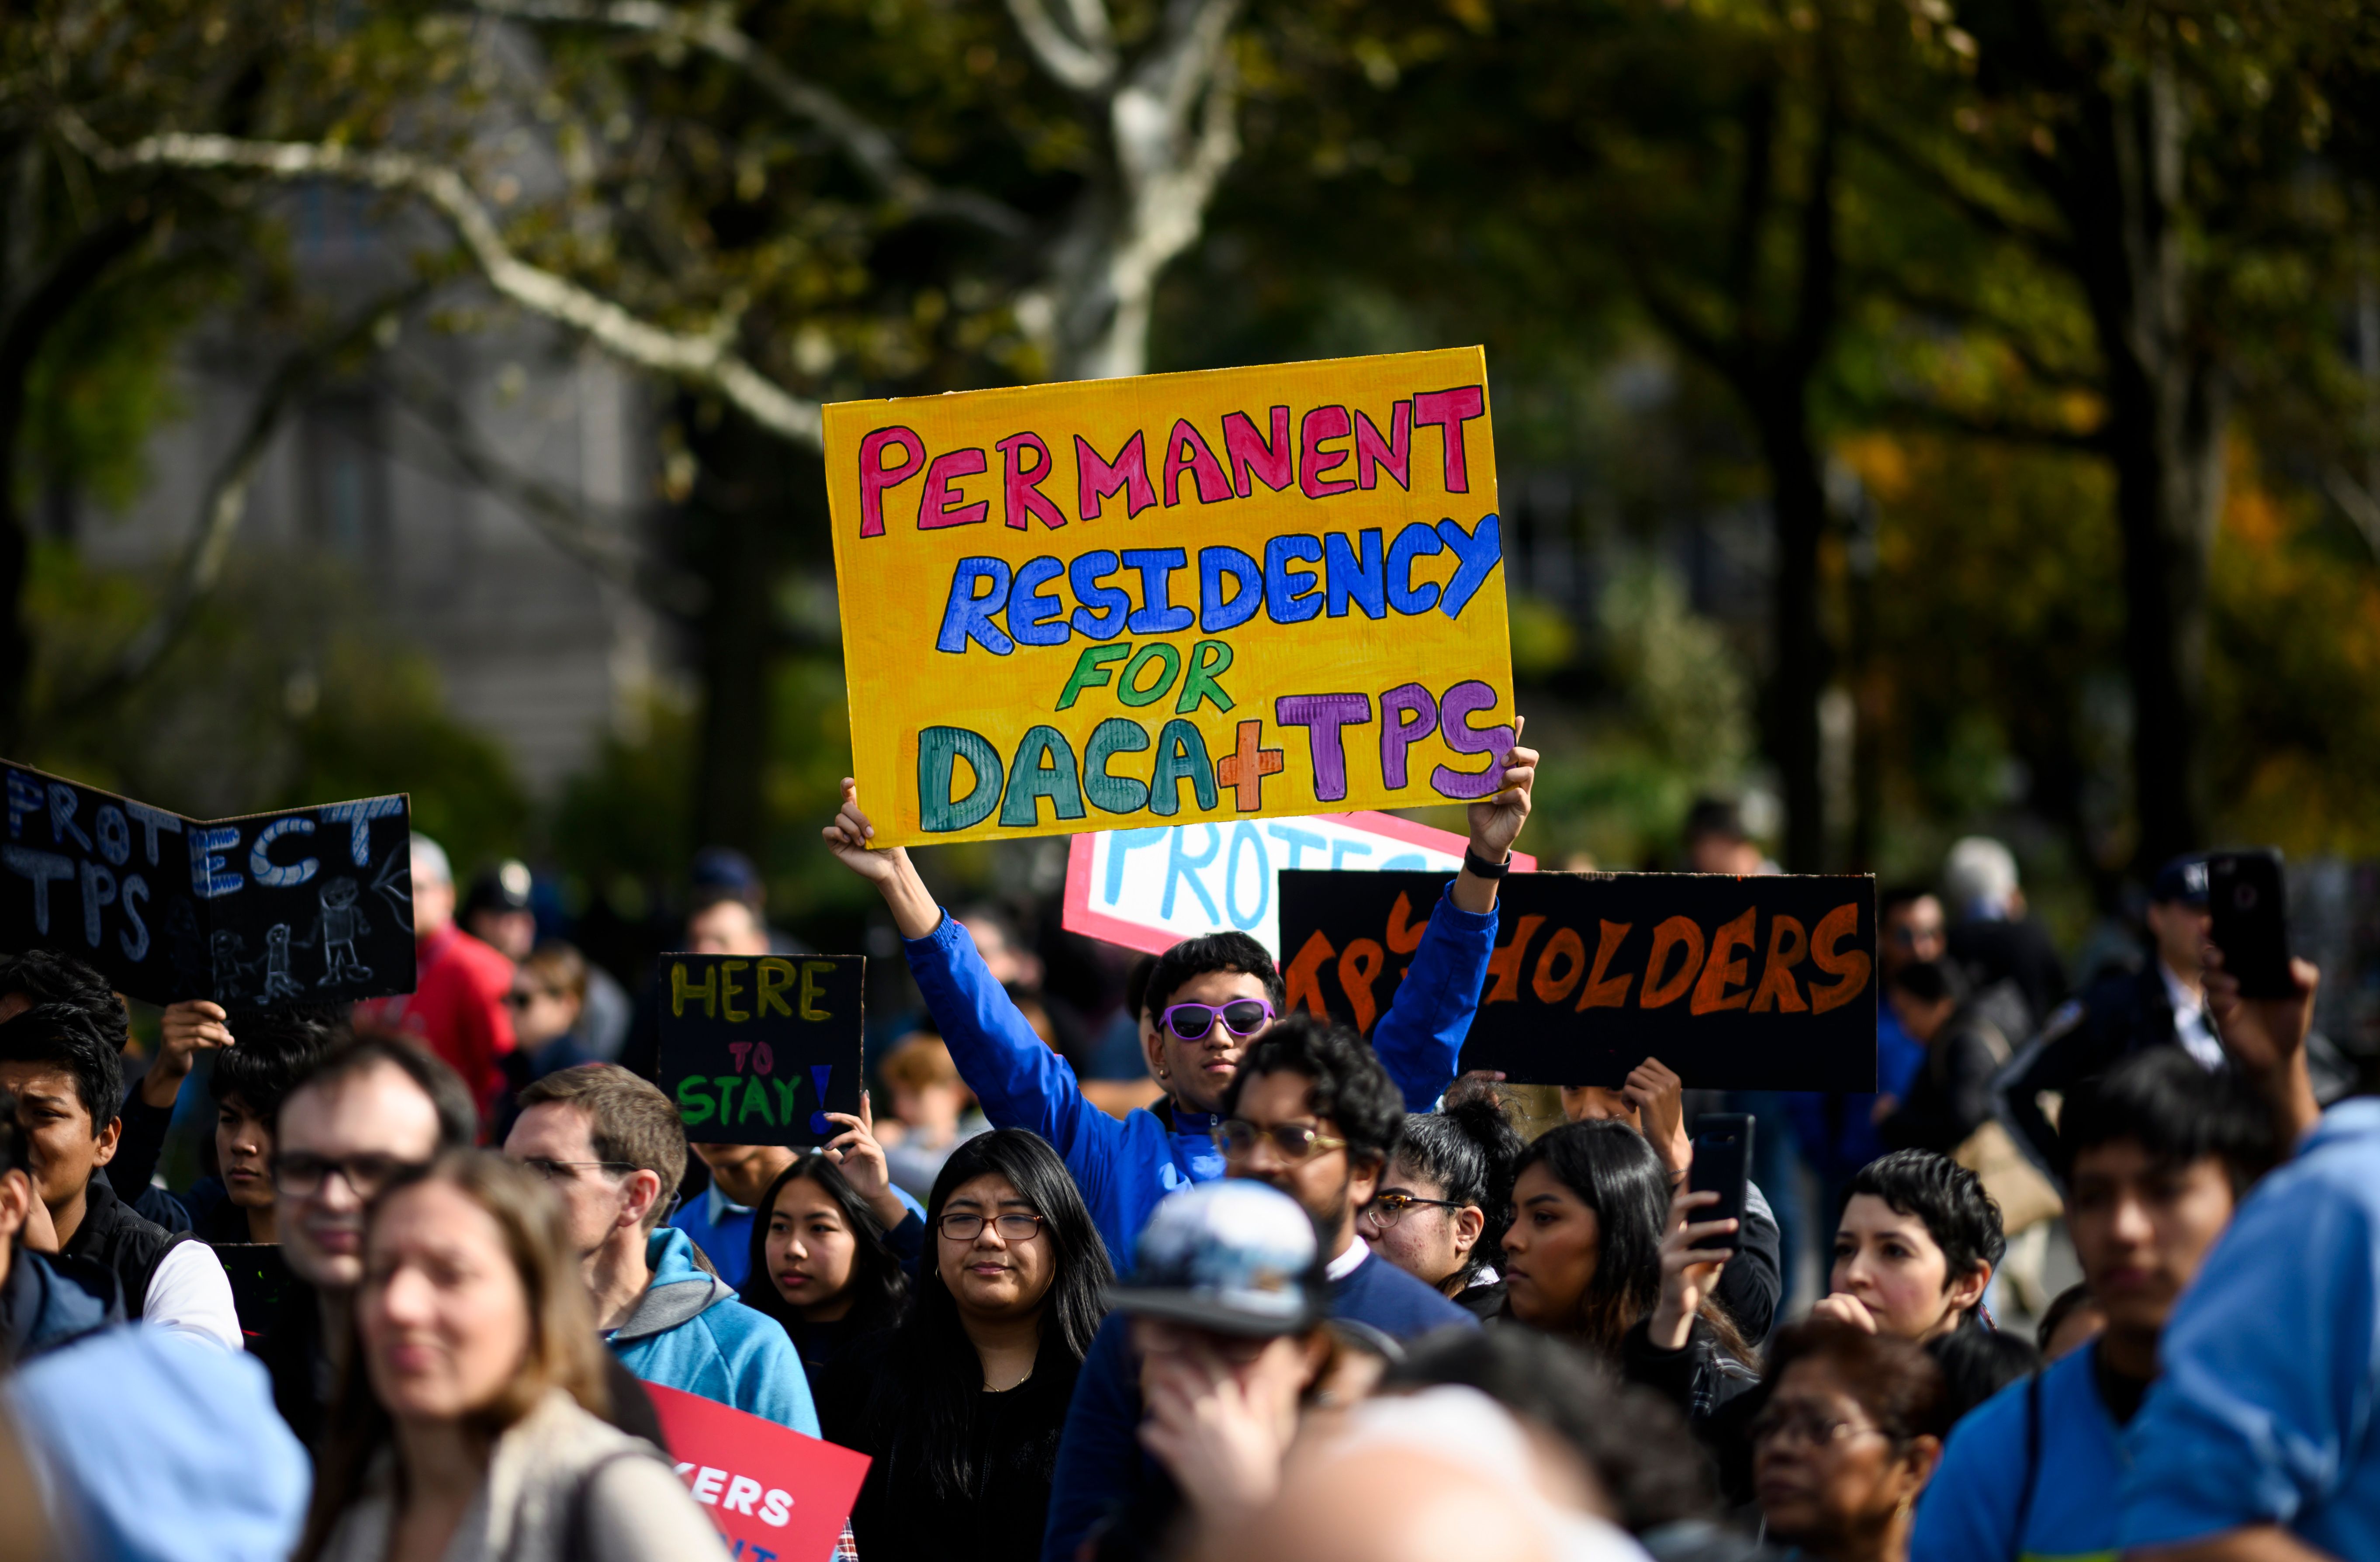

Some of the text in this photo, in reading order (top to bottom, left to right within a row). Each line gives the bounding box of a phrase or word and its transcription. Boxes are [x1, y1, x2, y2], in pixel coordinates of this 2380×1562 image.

[859, 384, 1485, 538] PERMANENT
[936, 513, 1503, 655] RESIDENCY
[1055, 640, 1236, 713] FOR
[6, 768, 405, 899] PROTECT
[1, 842, 151, 963] TPS
[671, 957, 837, 1022] HERE
[729, 1041, 774, 1076] TO
[673, 1462, 794, 1527] ERS
